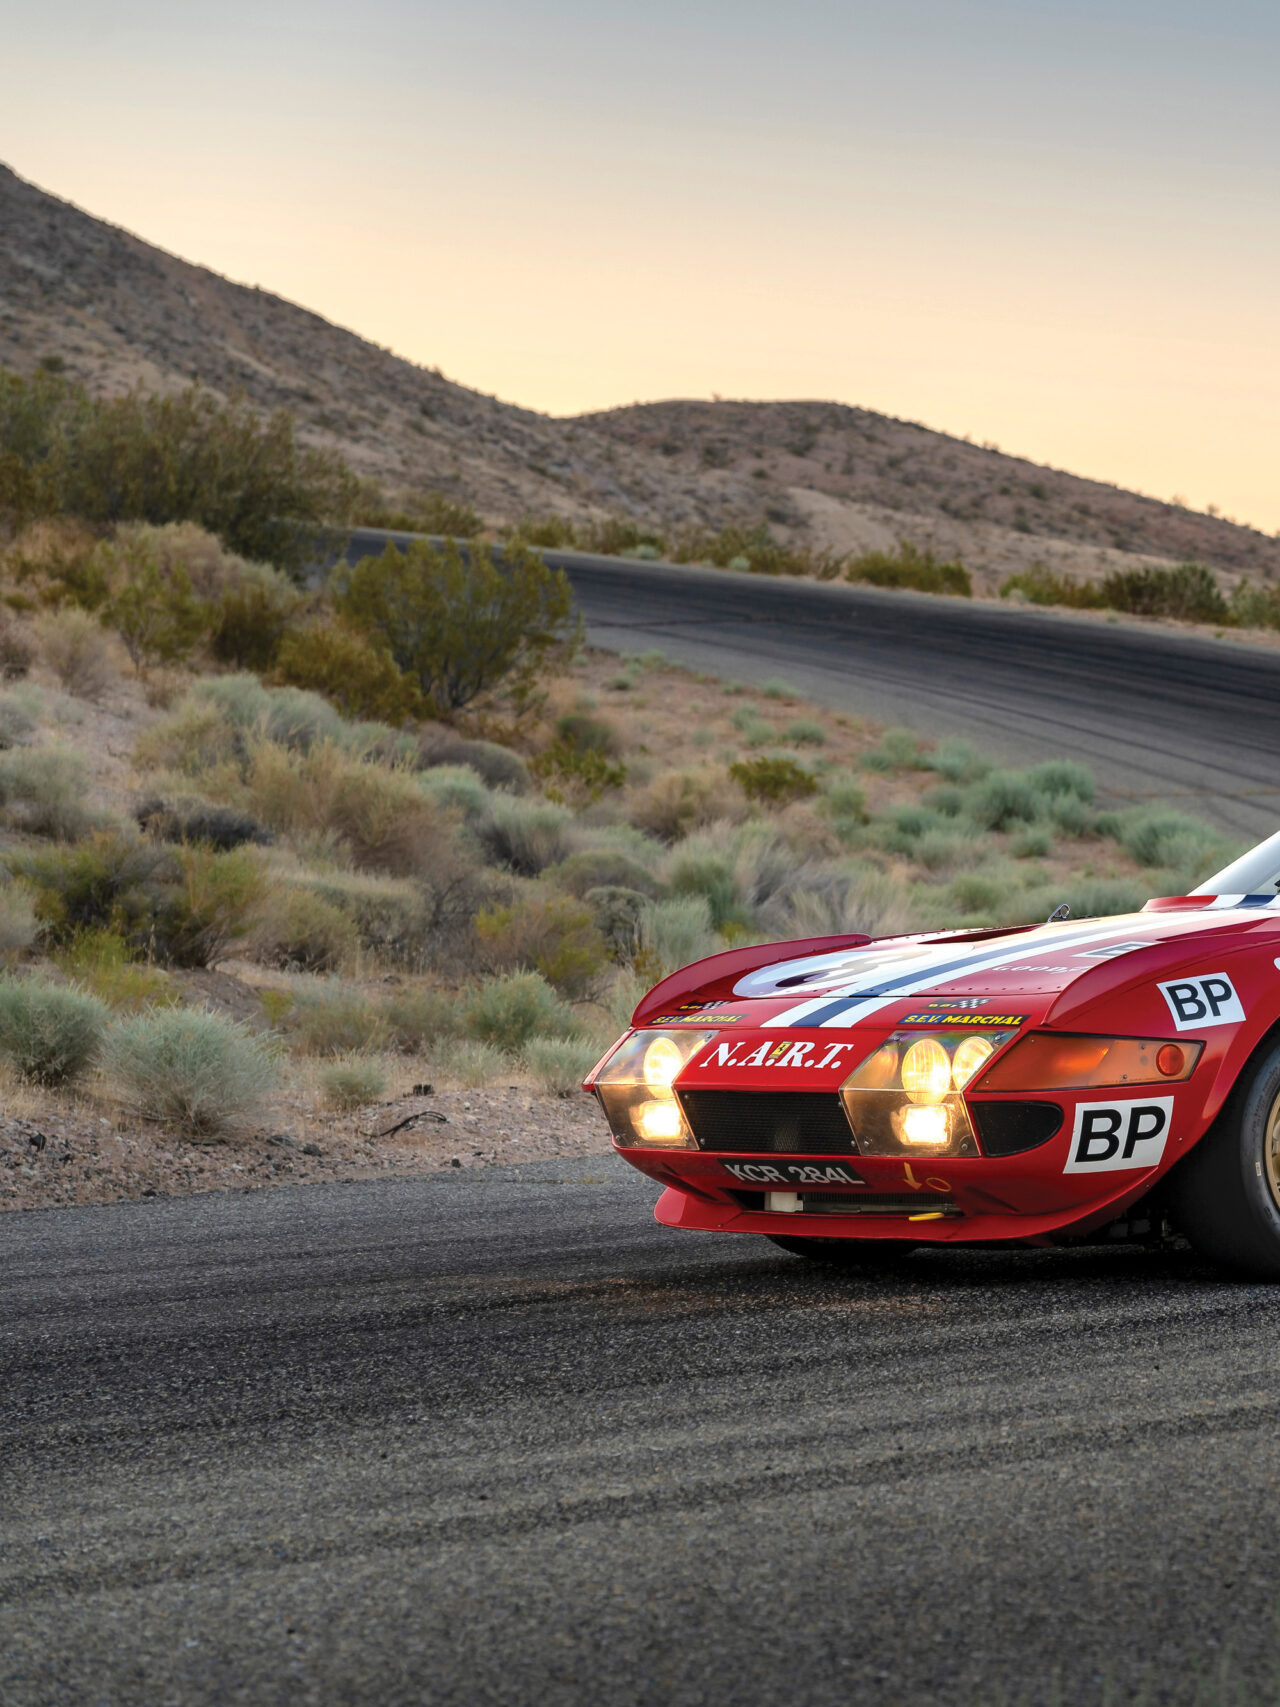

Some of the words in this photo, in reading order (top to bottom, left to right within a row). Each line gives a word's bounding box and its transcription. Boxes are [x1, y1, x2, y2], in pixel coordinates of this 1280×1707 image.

[1166, 978, 1233, 1023] BP
[940, 1015, 1023, 1025] MARCHAL
[699, 1041, 855, 1069] N.A.R.T.
[1074, 1105, 1166, 1163] BP
[724, 1164, 790, 1183] KCR
[788, 1166, 866, 1184] 284L
